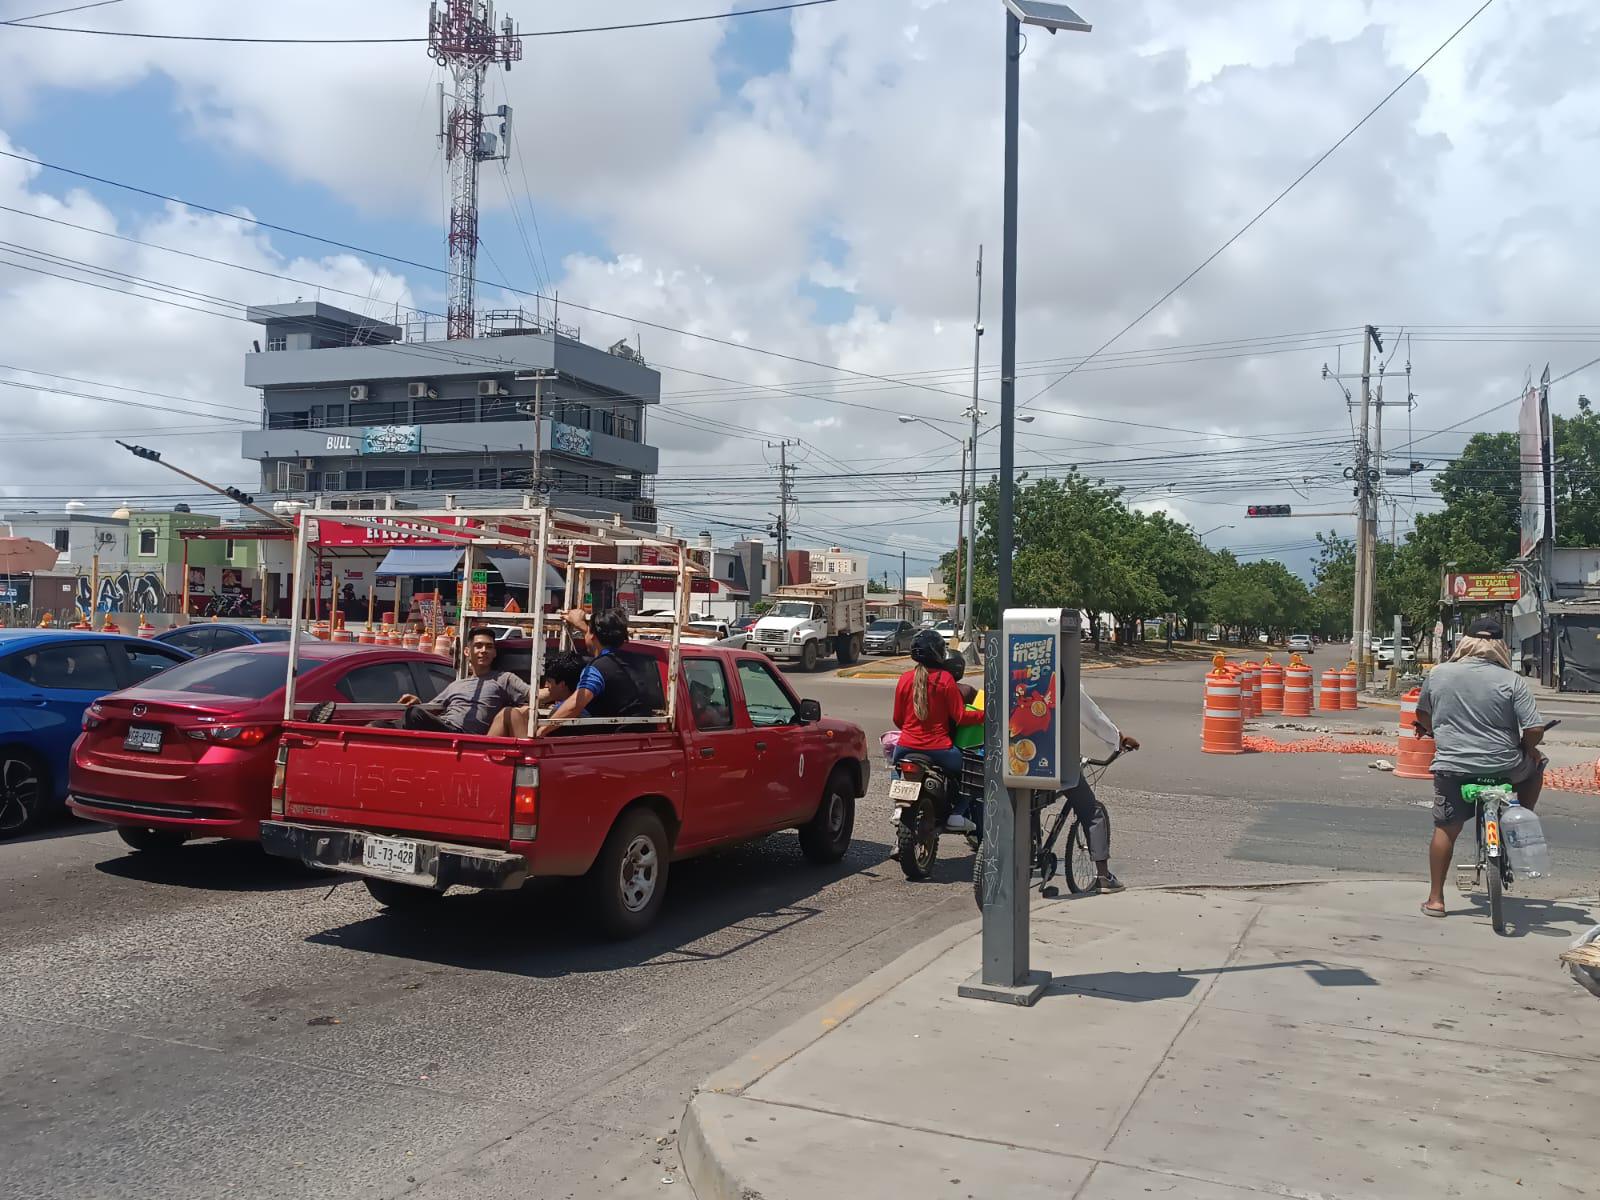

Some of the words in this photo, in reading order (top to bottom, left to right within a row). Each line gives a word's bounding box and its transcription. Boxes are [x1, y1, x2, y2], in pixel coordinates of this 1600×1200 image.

[326, 436, 351, 450] BULL
[366, 527, 379, 539] EL
[367, 844, 414, 864] UL-73-428
